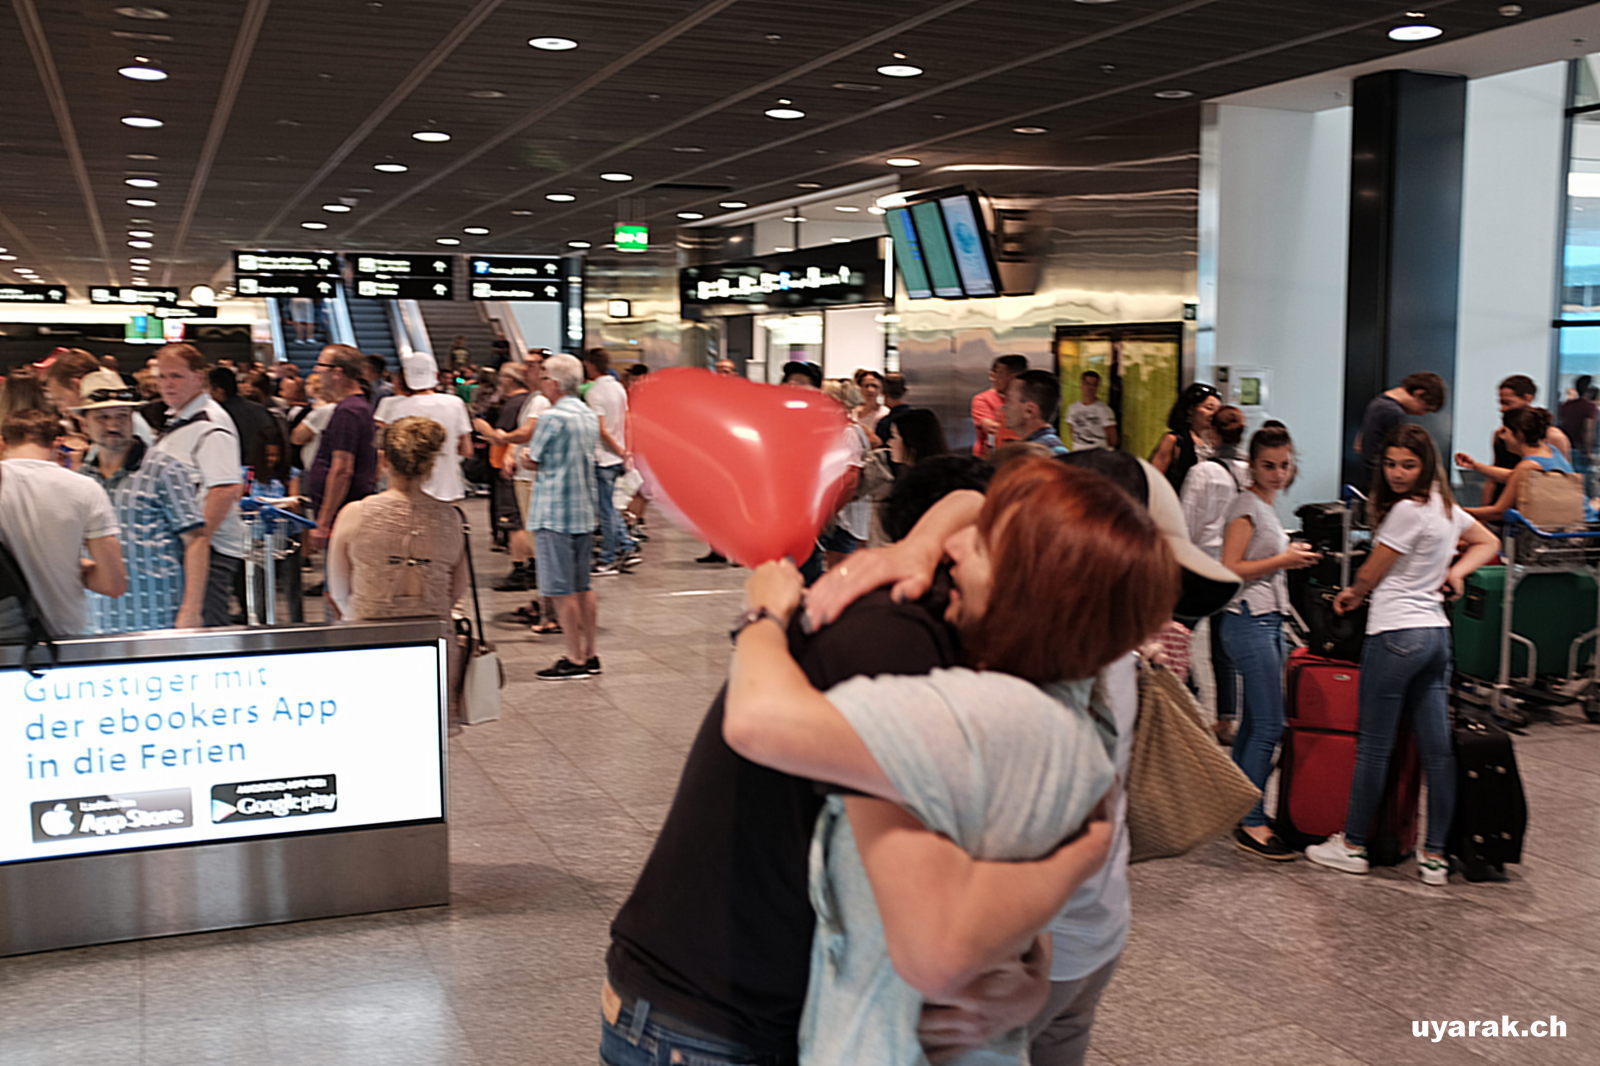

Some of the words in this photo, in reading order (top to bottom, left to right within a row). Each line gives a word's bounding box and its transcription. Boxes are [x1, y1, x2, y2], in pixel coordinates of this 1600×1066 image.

[215, 667, 267, 689] mit
[25, 713, 84, 741] der
[99, 702, 259, 734] ebookers
[273, 696, 337, 726] App
[26, 752, 58, 779] in
[74, 748, 127, 775] die
[141, 739, 246, 769] Ferien
[236, 793, 301, 817] Google
[300, 792, 337, 813] play
[79, 813, 127, 835] App
[126, 808, 184, 829] Store
